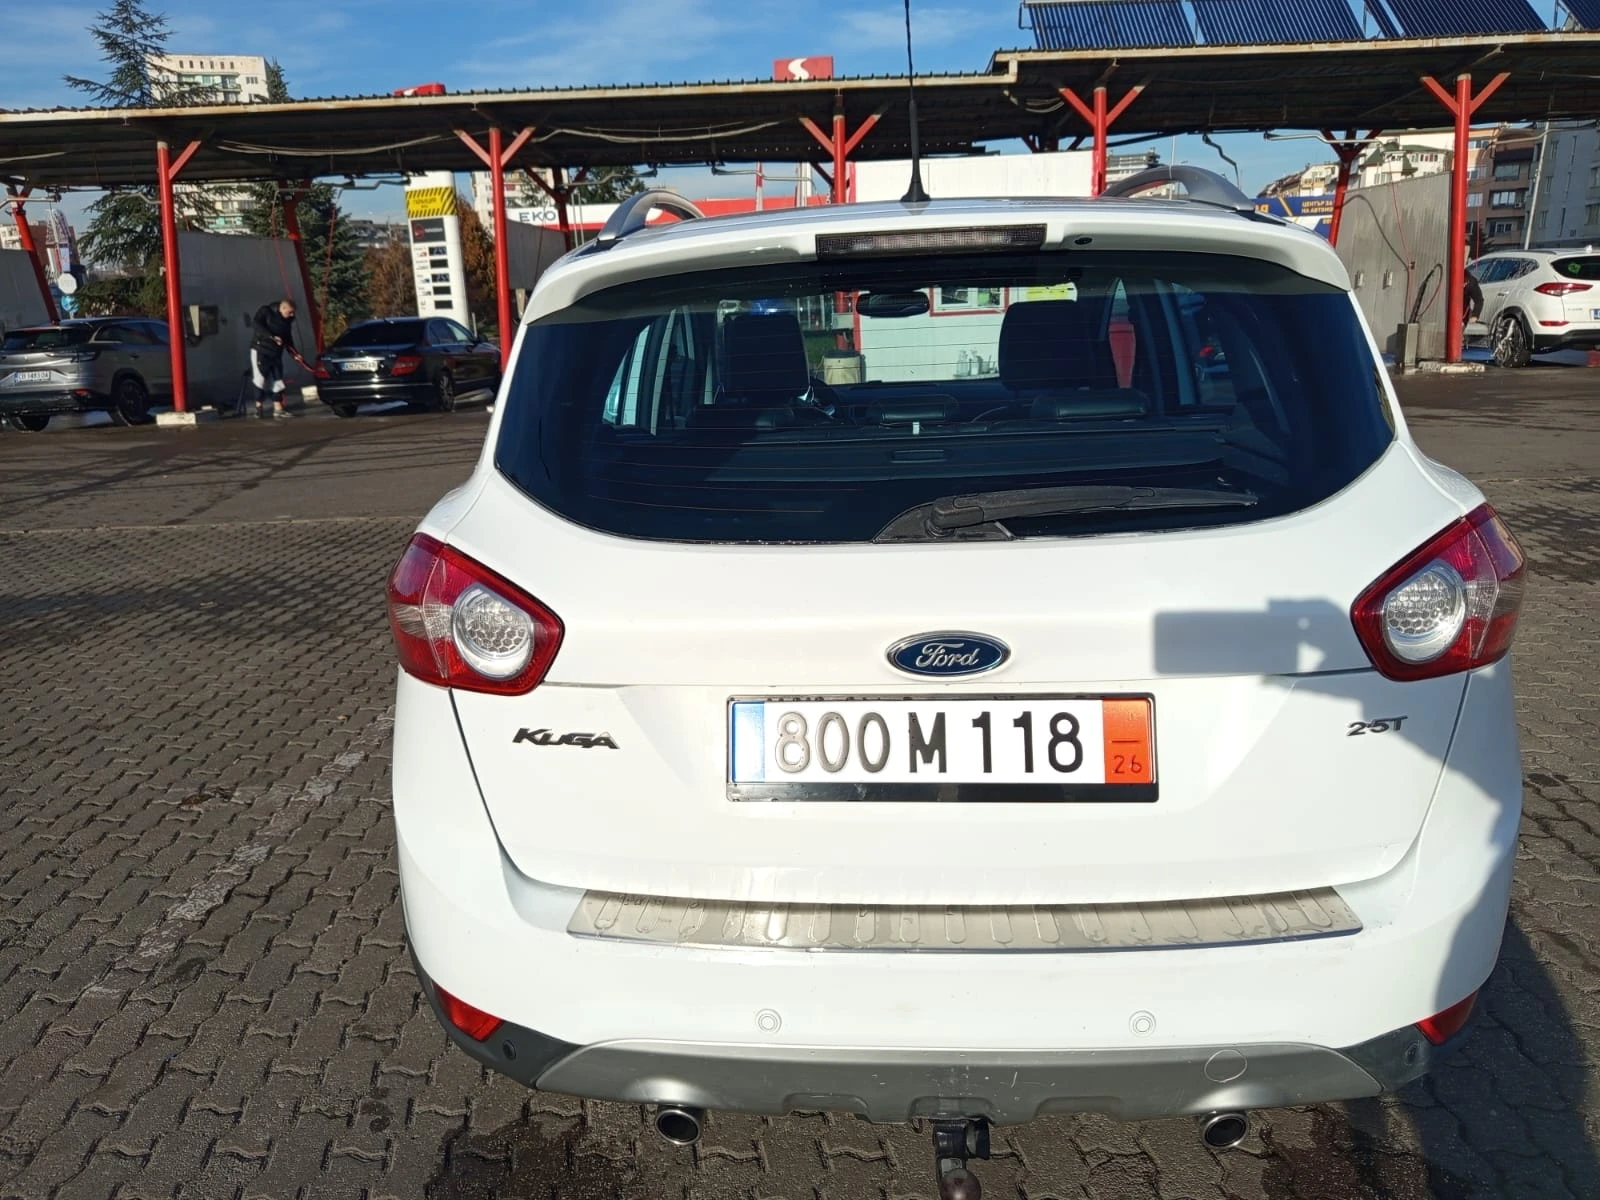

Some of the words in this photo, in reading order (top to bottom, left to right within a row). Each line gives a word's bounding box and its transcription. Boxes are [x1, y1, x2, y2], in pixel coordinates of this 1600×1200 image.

[519, 211, 556, 222] EKO
[914, 642, 980, 668] Ford
[512, 727, 621, 749] KUGA
[774, 711, 891, 774] 800
[908, 711, 948, 773] M
[970, 711, 1084, 774] 118
[1113, 754, 1143, 774] 26
